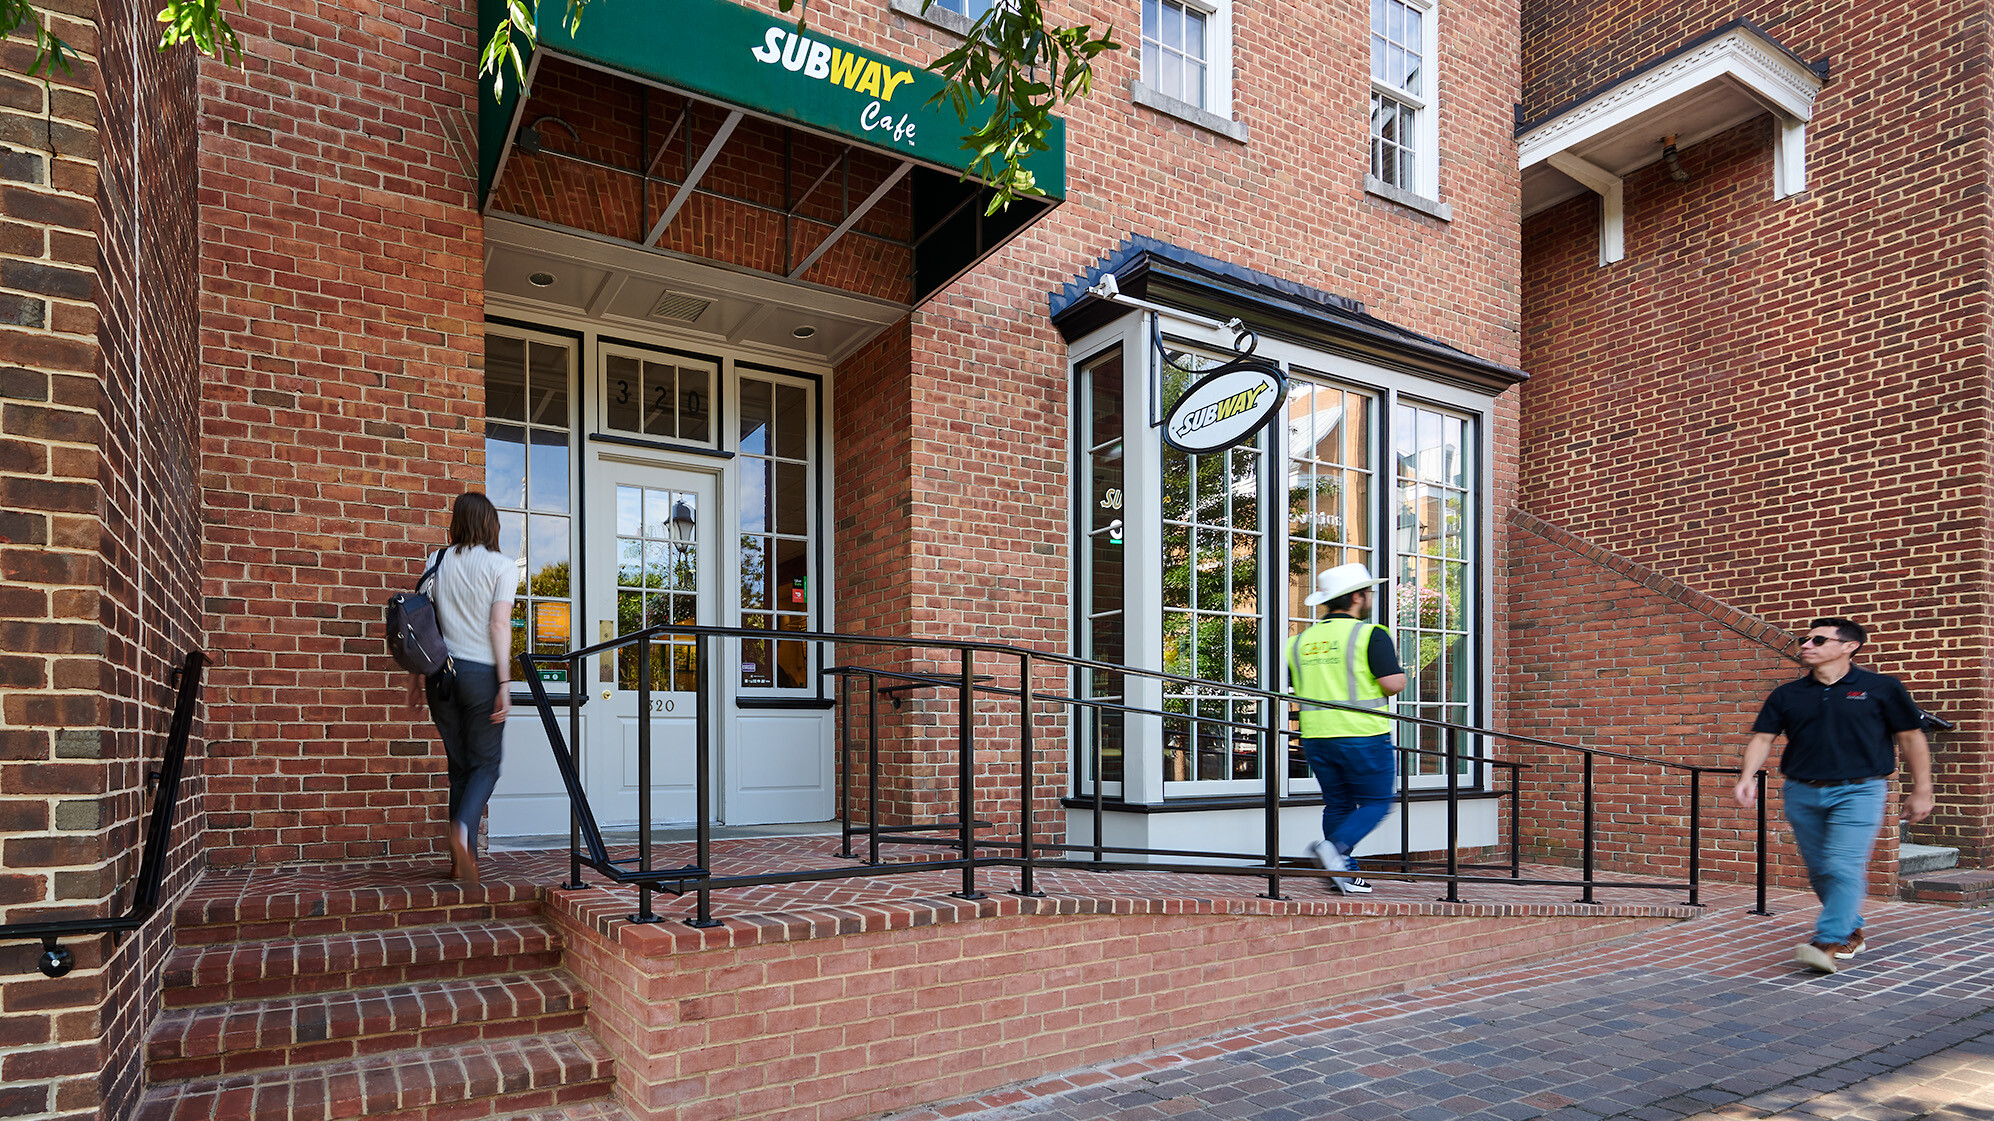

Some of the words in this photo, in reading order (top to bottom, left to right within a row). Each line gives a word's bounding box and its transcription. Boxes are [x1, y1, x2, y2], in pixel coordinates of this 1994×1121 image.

[751, 27, 914, 102] SUBWAY
[860, 101, 916, 142] Cafe
[1176, 380, 1269, 438] SUBWAY
